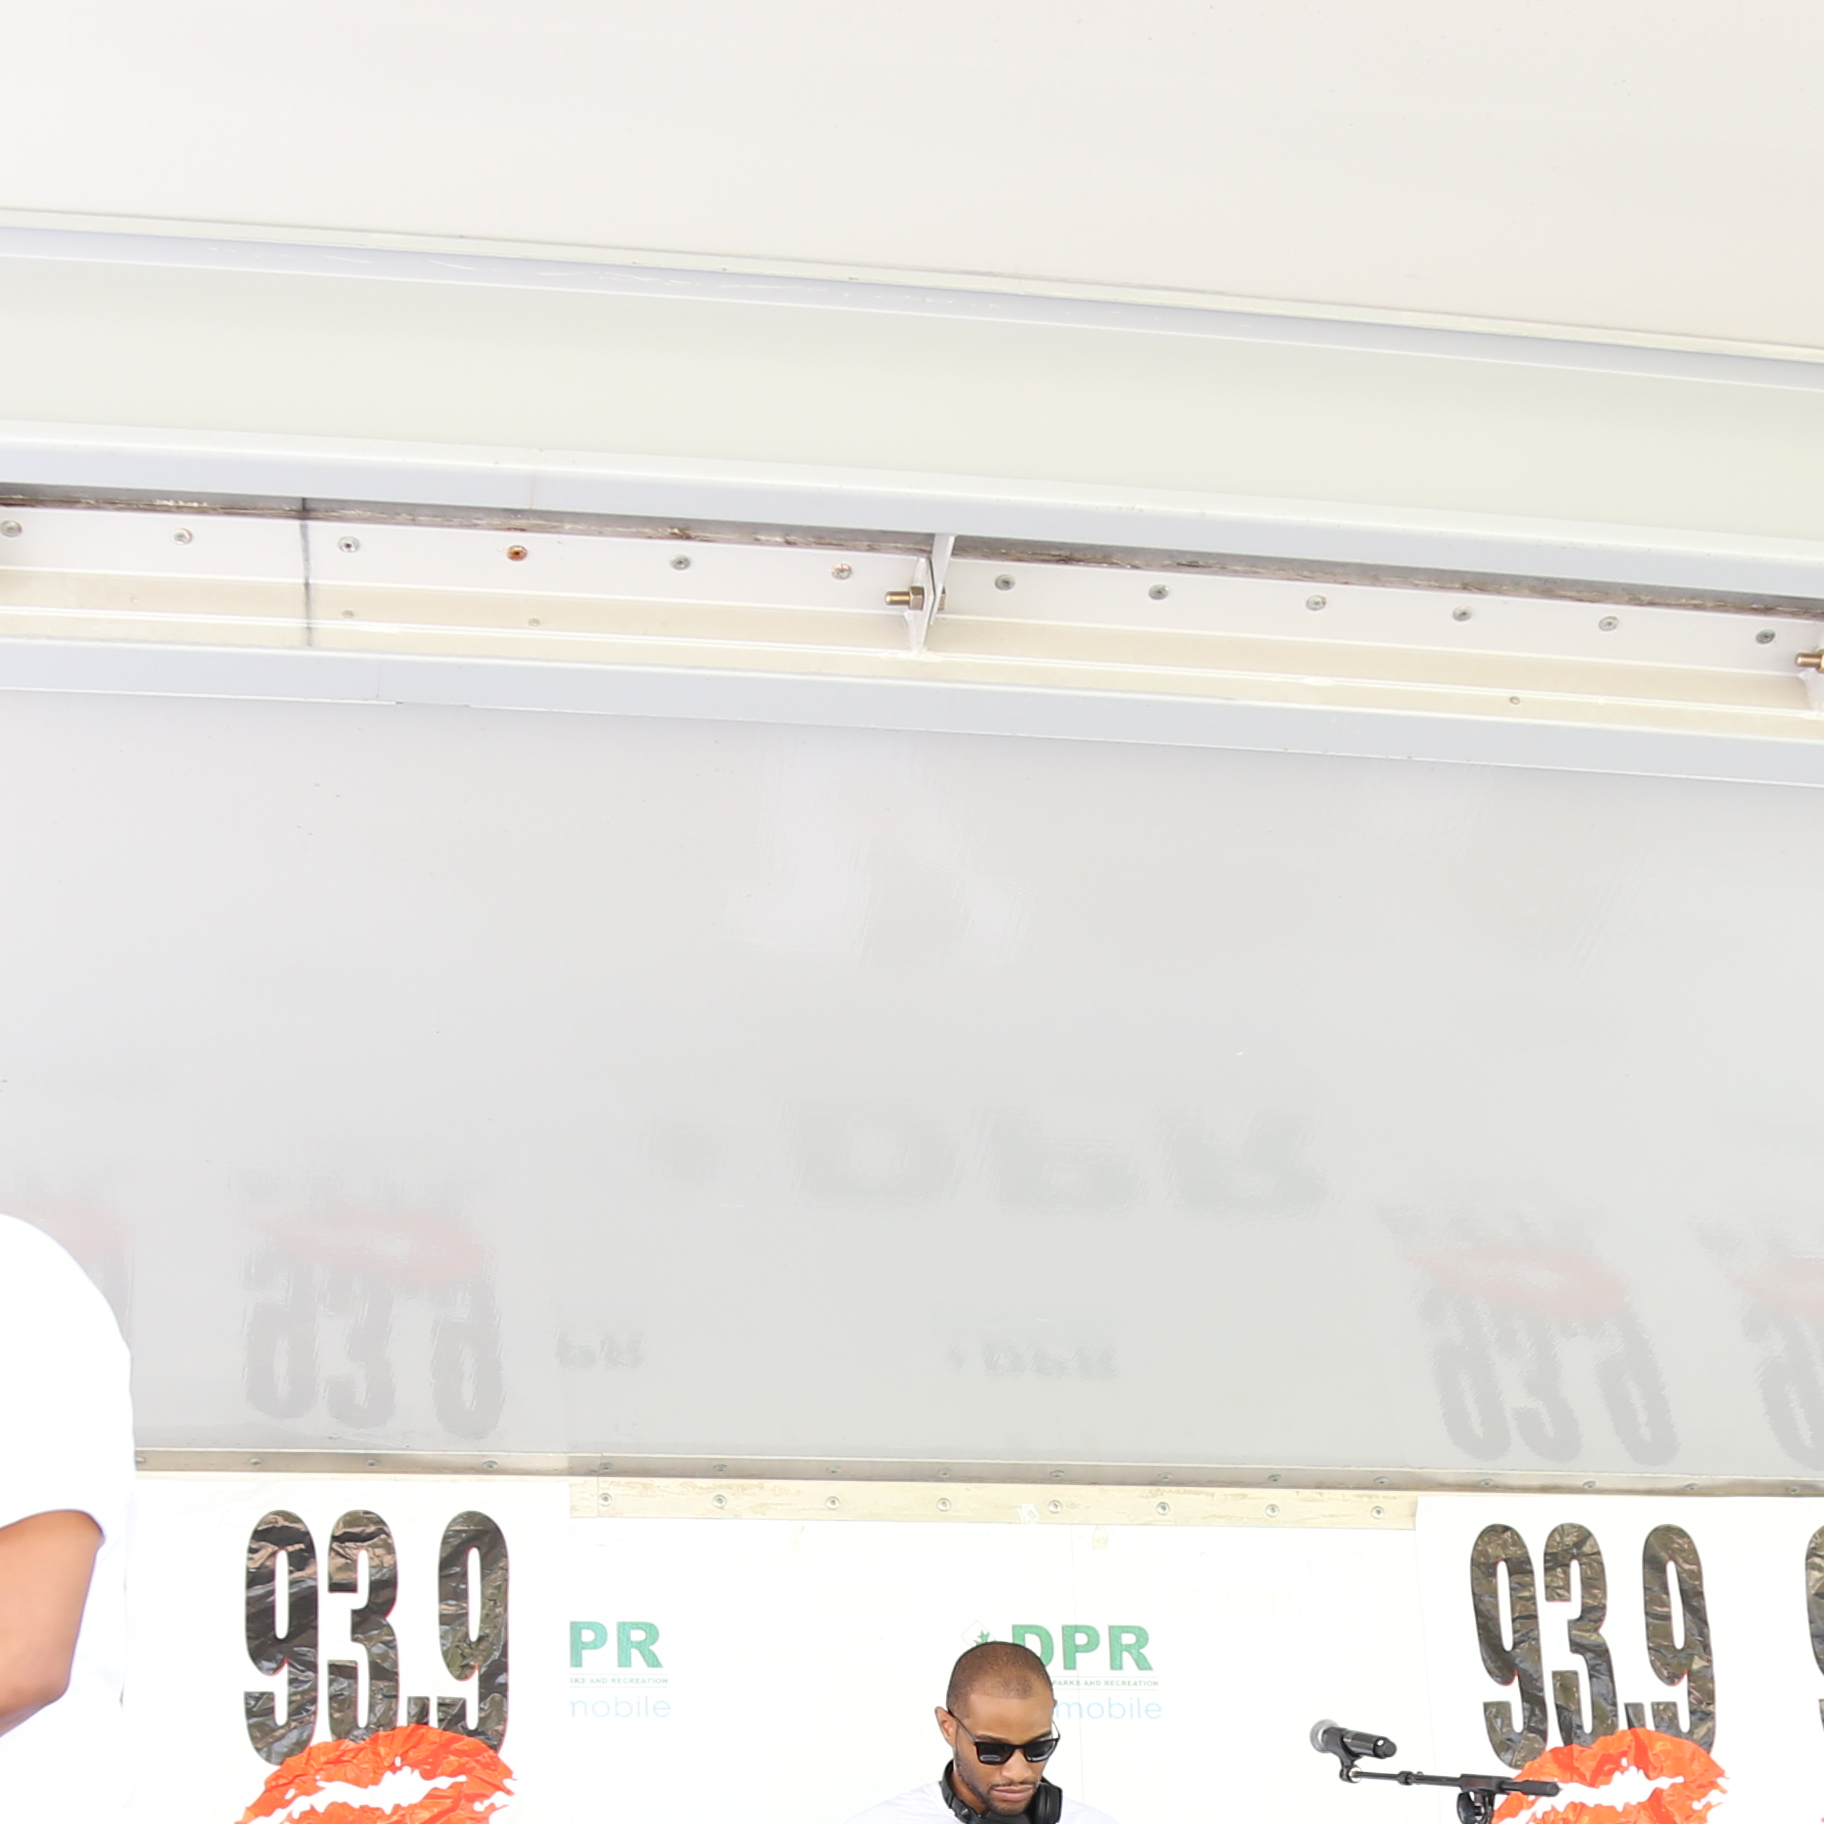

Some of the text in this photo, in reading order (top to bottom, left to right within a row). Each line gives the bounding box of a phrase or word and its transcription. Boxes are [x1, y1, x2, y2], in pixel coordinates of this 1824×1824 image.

[244, 1509, 510, 1766] 93.9
[569, 1620, 664, 1668] PR
[1012, 1624, 1154, 1671] DPR
[1470, 1522, 1717, 1770] 93.9
[1055, 1697, 1163, 1720] mobile
